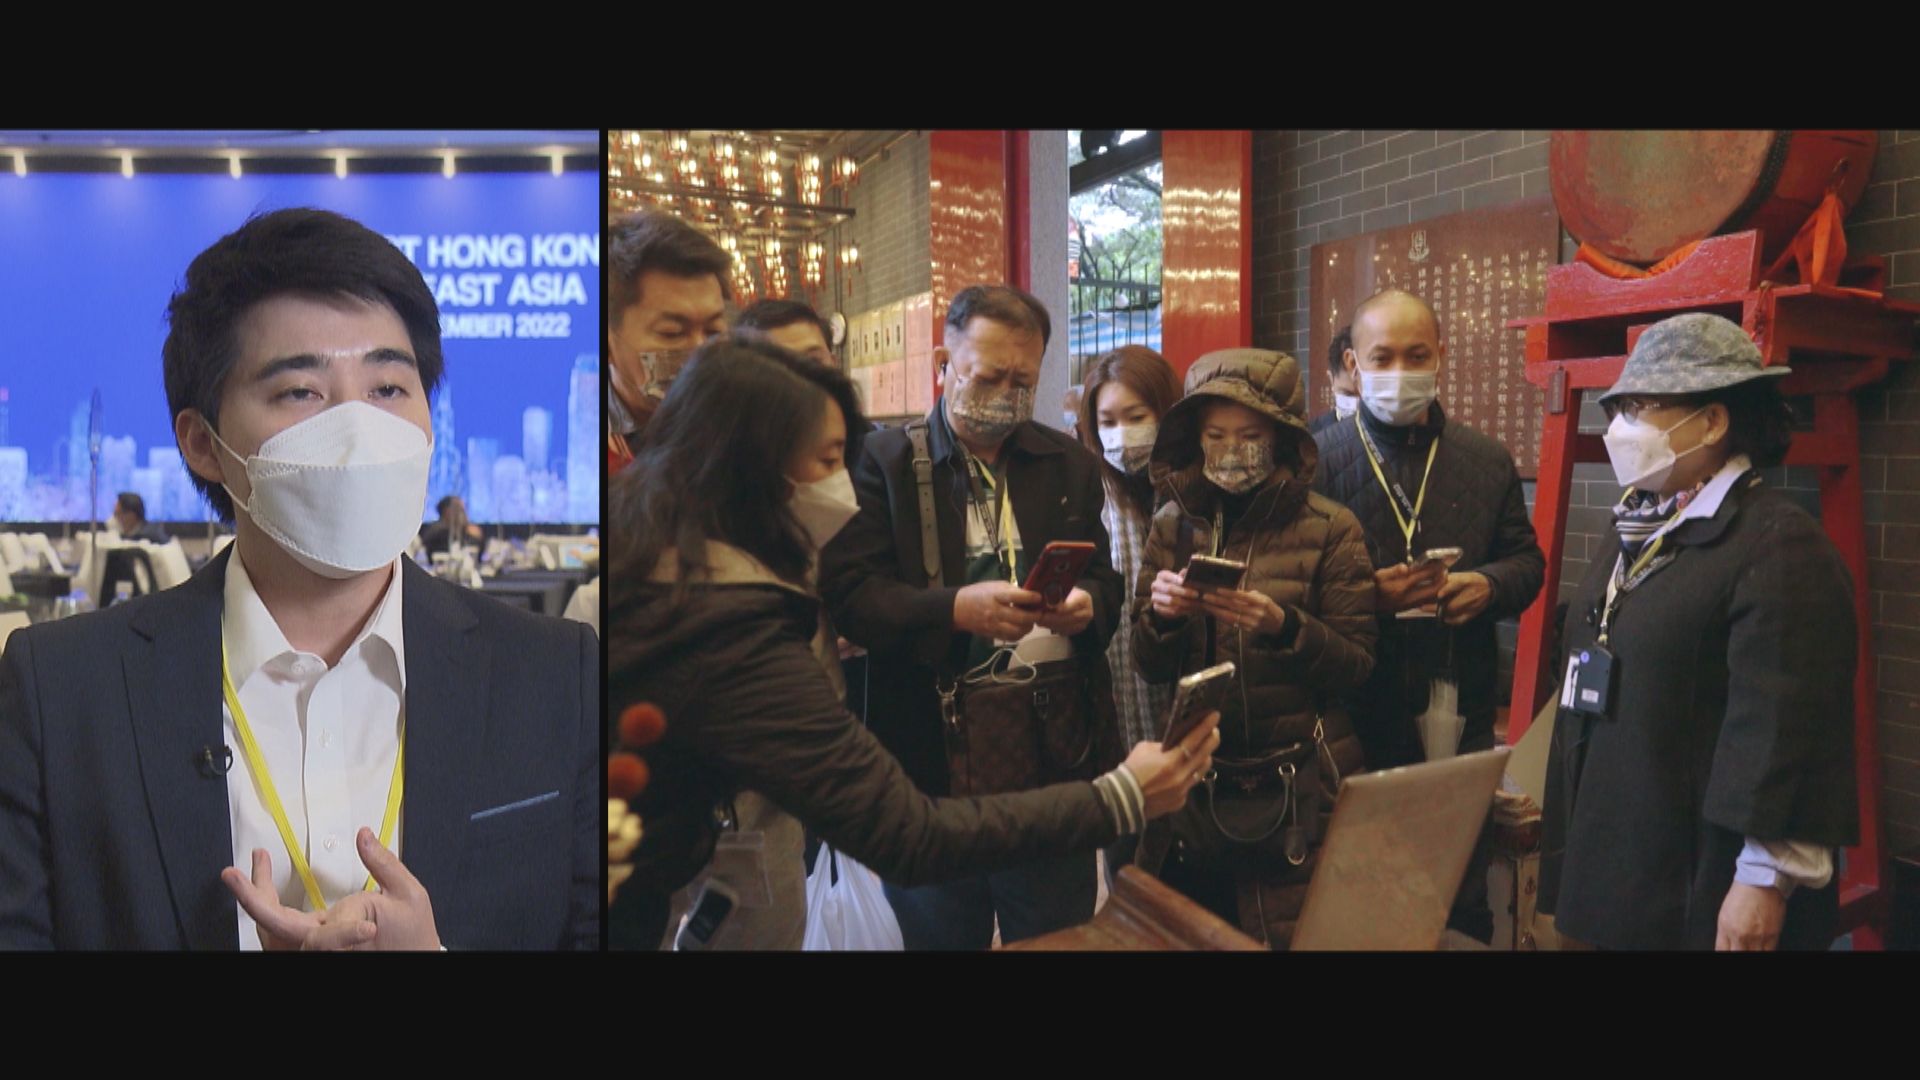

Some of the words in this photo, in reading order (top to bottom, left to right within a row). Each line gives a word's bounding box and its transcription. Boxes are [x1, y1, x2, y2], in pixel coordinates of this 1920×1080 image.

[427, 233, 526, 269] HONG
[531, 232, 599, 268] KON
[507, 271, 588, 307] ASIA
[515, 311, 571, 338] 2022
